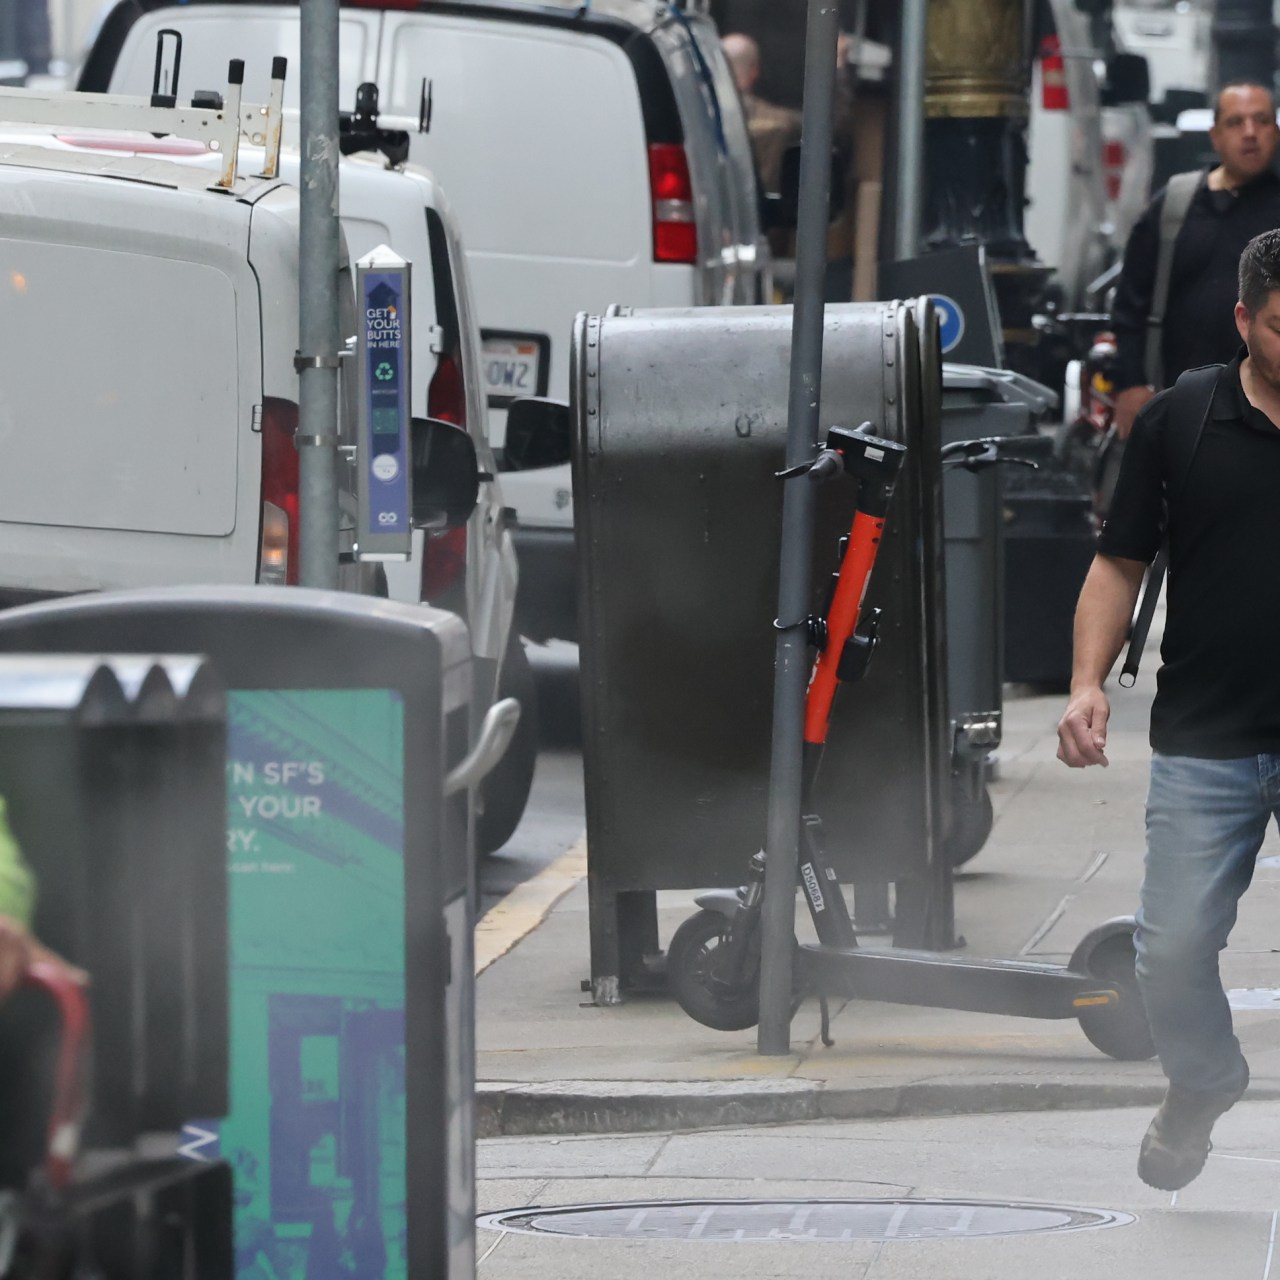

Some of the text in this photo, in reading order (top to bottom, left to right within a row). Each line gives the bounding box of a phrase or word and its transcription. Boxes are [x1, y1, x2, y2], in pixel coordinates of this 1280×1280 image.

[366, 308, 388, 318] GET
[367, 319, 400, 329] YOUR
[367, 330, 401, 340] BUTTS
[264, 761, 325, 785] SF'S
[239, 795, 322, 819] YOUR
